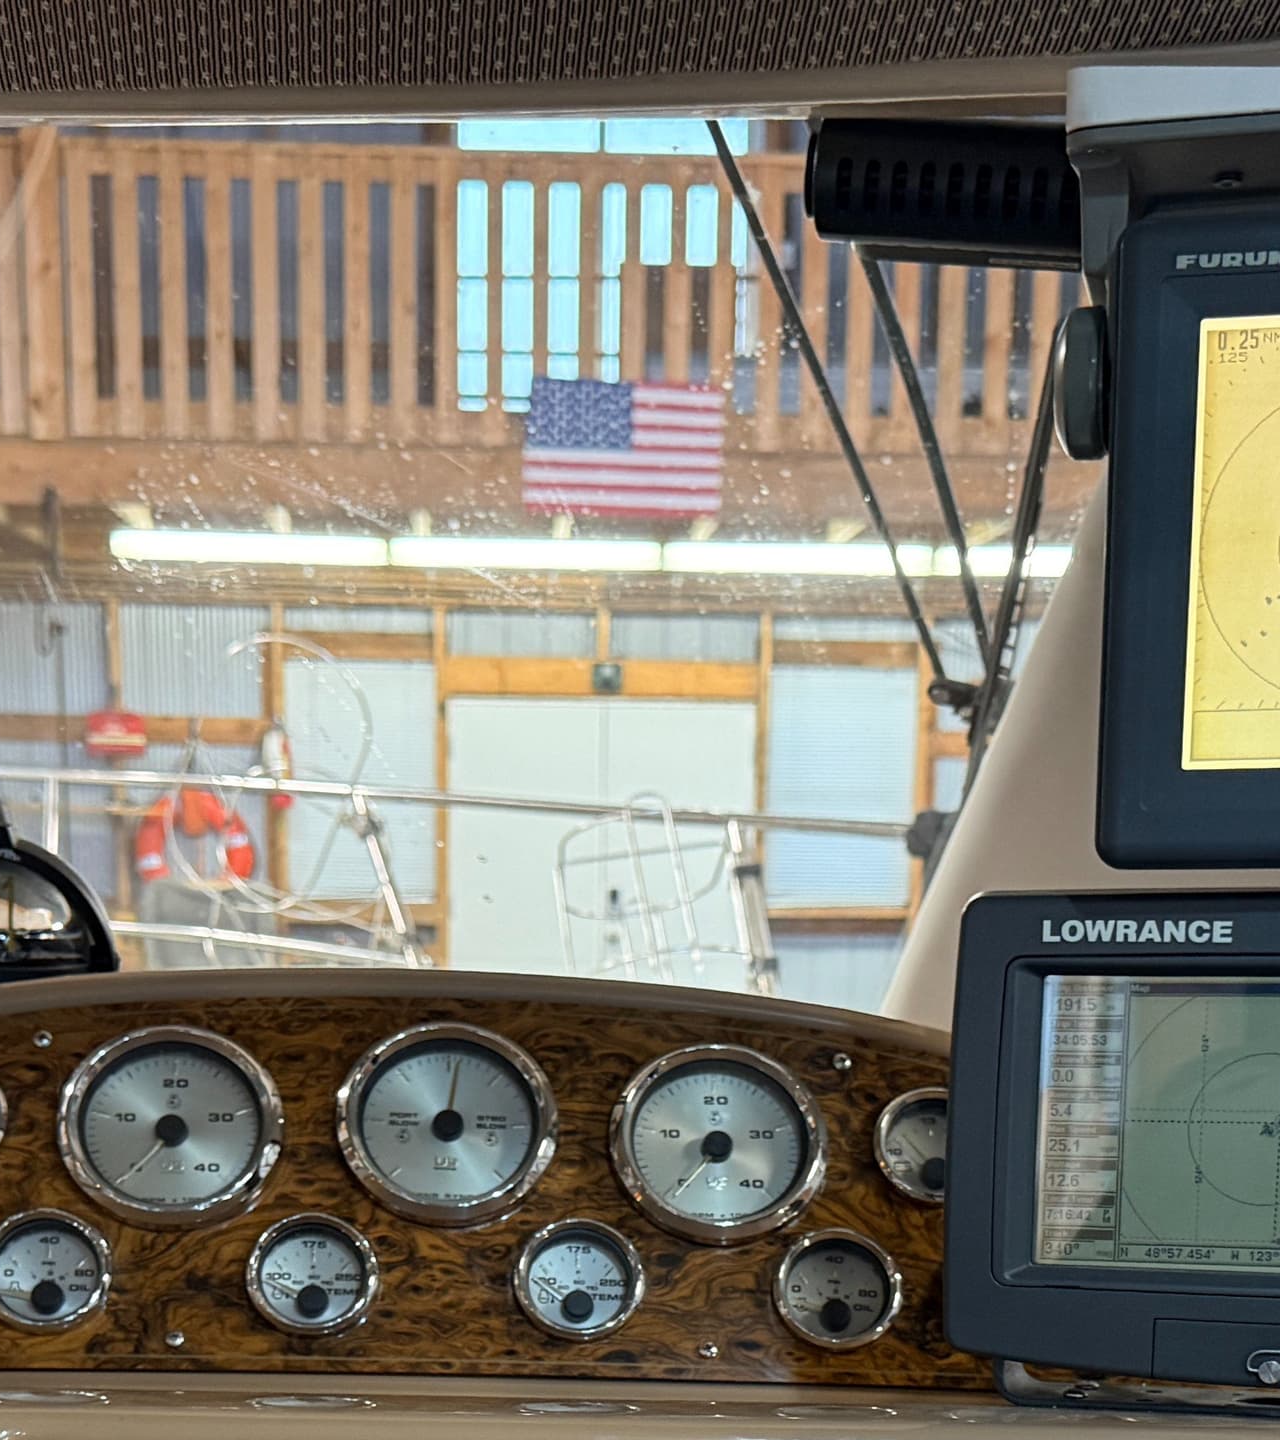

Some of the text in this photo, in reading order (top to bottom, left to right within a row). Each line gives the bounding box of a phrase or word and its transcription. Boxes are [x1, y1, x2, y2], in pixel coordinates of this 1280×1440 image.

[1218, 328, 1260, 351] 0.25
[1042, 919, 1234, 944] LOWRANCE
[1051, 1069, 1074, 1083] 0.0
[163, 1078, 189, 1089] 20
[704, 1095, 729, 1106] 20
[1049, 1103, 1072, 1117] 5.4
[115, 1112, 137, 1123] 10
[208, 1112, 235, 1123] 30
[388, 1119, 419, 1127] SLOW
[659, 1128, 681, 1139] 10
[749, 1129, 775, 1140] 30
[1048, 1138, 1080, 1153] 25.1
[194, 1162, 221, 1173] 40
[739, 1178, 765, 1189] 40
[1047, 1173, 1079, 1187] 12.6
[39, 1236, 60, 1245] 40
[566, 1245, 592, 1254] 175
[1120, 1246, 1129, 1257] N
[1230, 1250, 1240, 1261] W
[825, 1255, 844, 1264] 40
[68, 1283, 90, 1292] OIL
